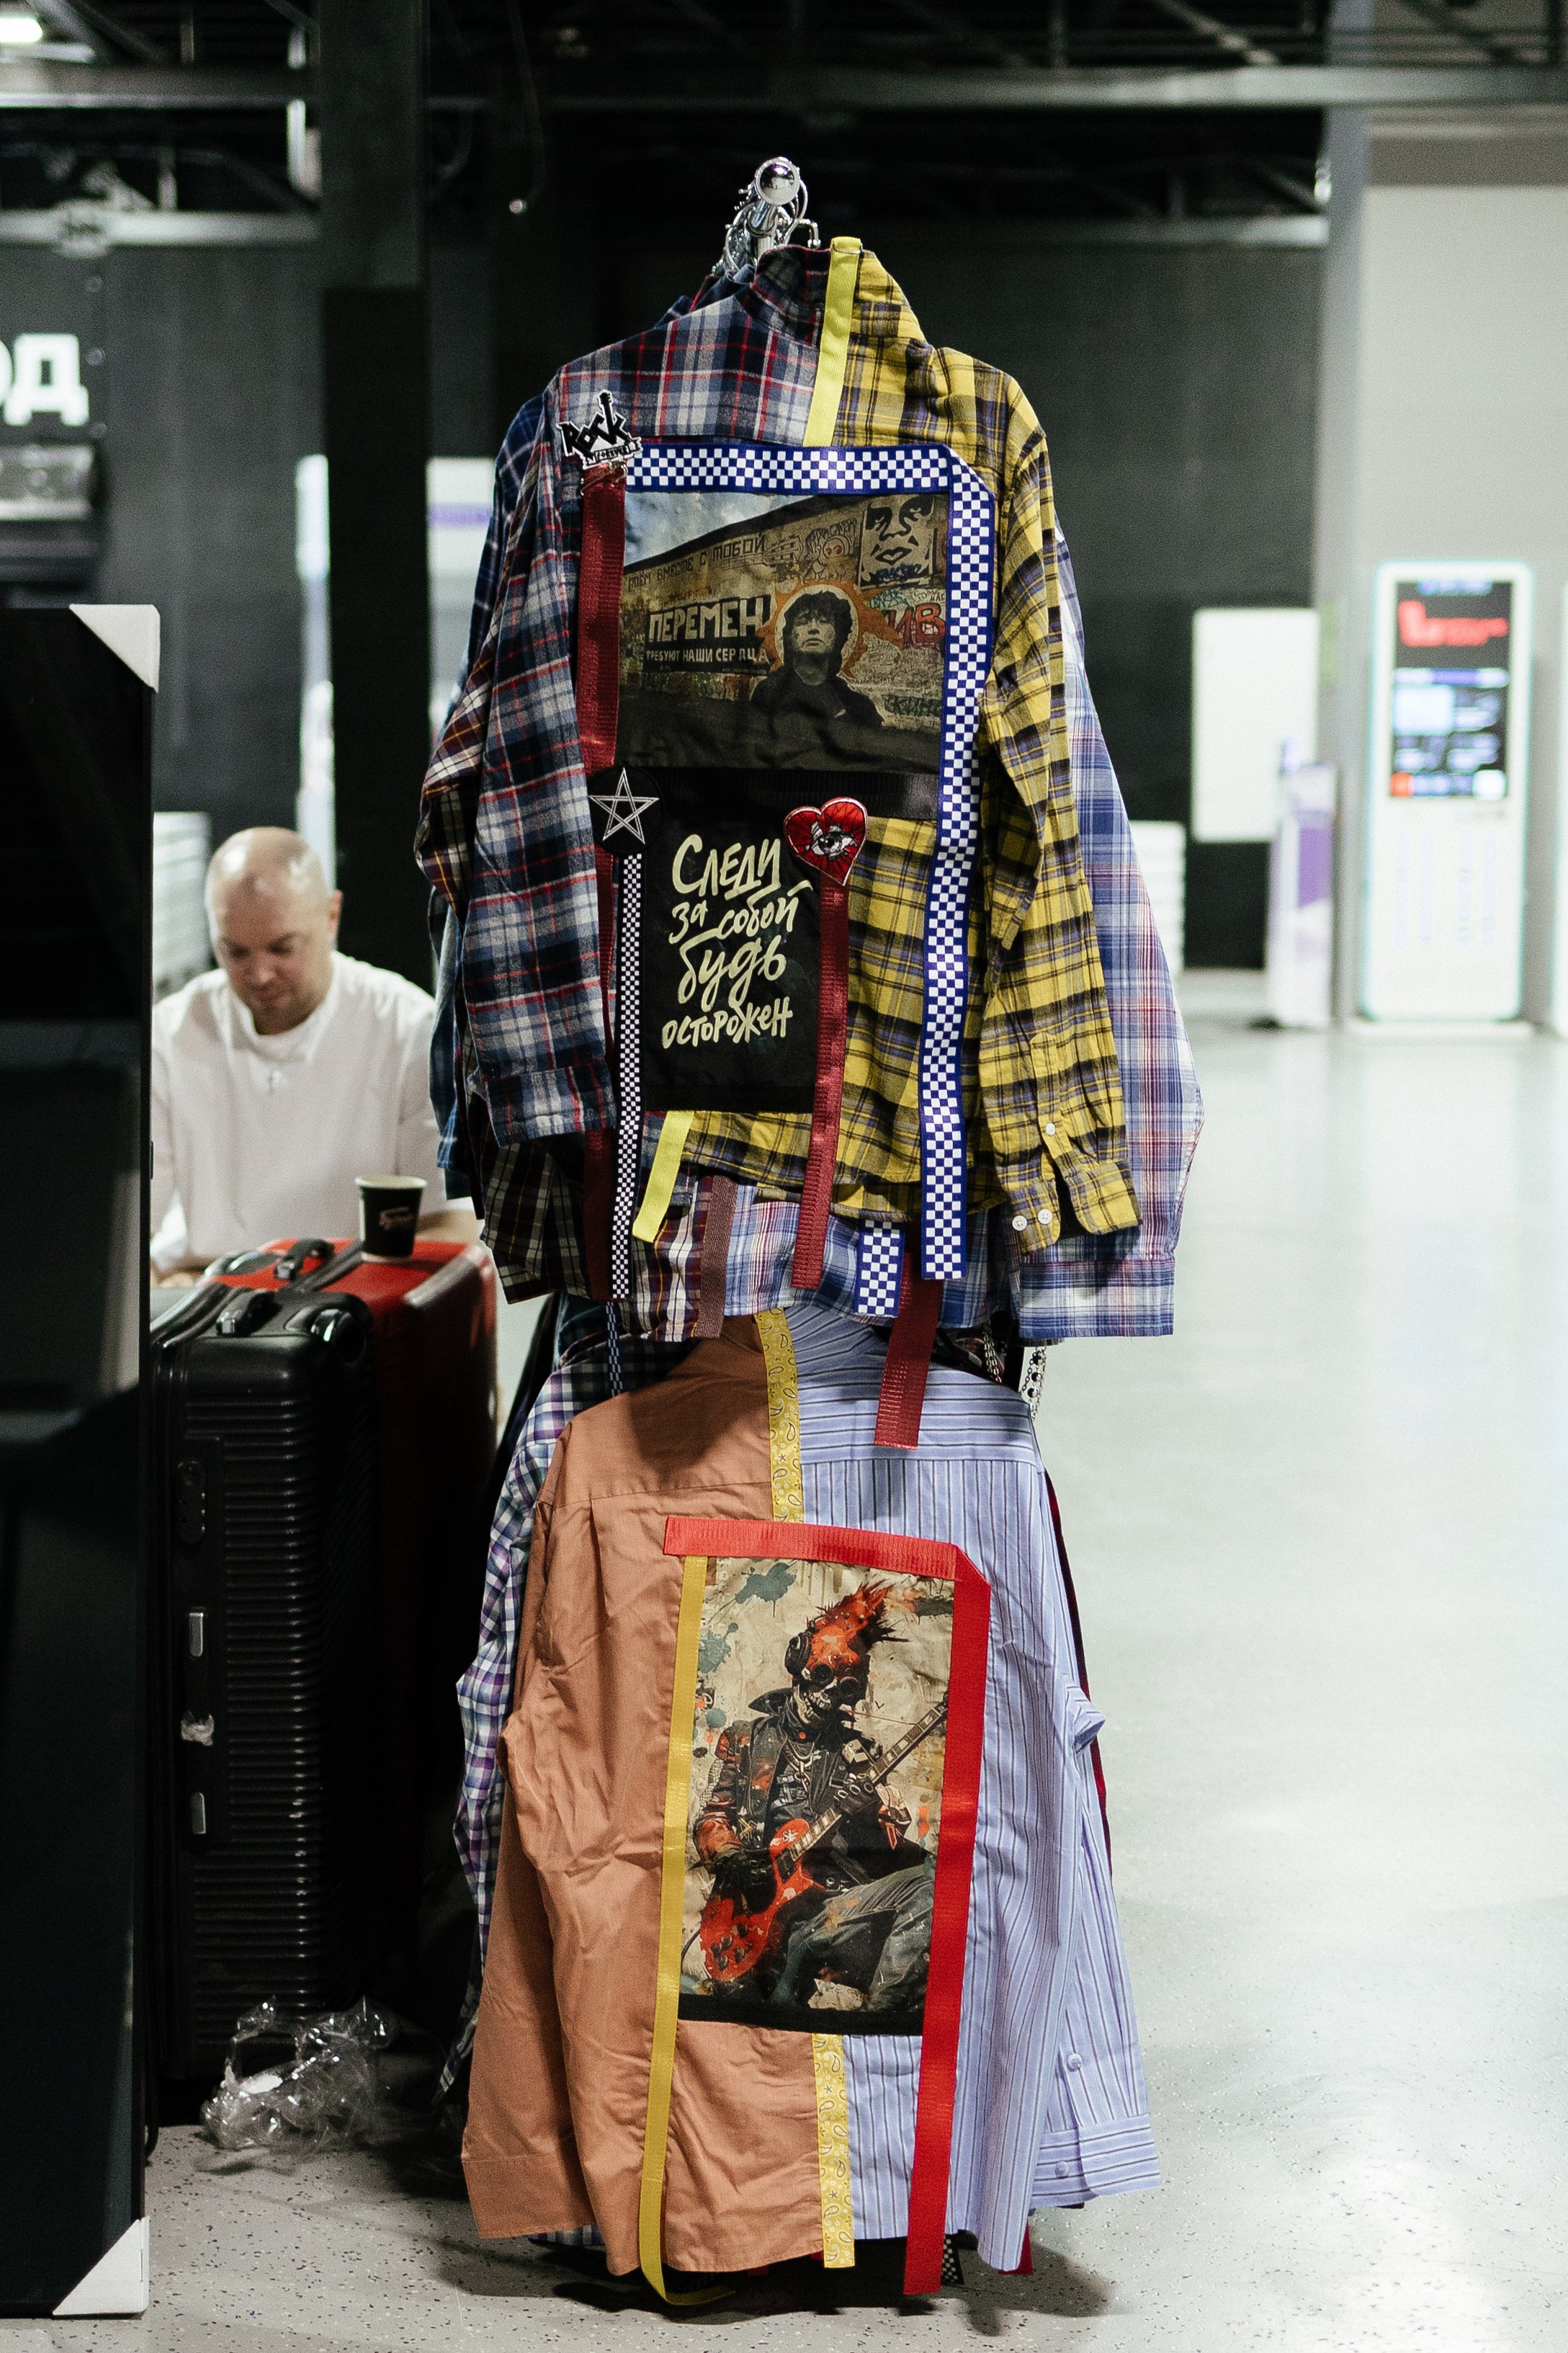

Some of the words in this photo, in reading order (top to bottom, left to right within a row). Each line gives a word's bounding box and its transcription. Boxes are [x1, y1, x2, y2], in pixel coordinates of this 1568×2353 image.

[0, 334, 90, 427] Д
[649, 597, 763, 642] ПЕРЕМЕН
[646, 650, 681, 662] ТРЕБУЮТ
[684, 648, 713, 663] НАШИ
[717, 880, 813, 939] собой
[678, 928, 787, 1012] будь
